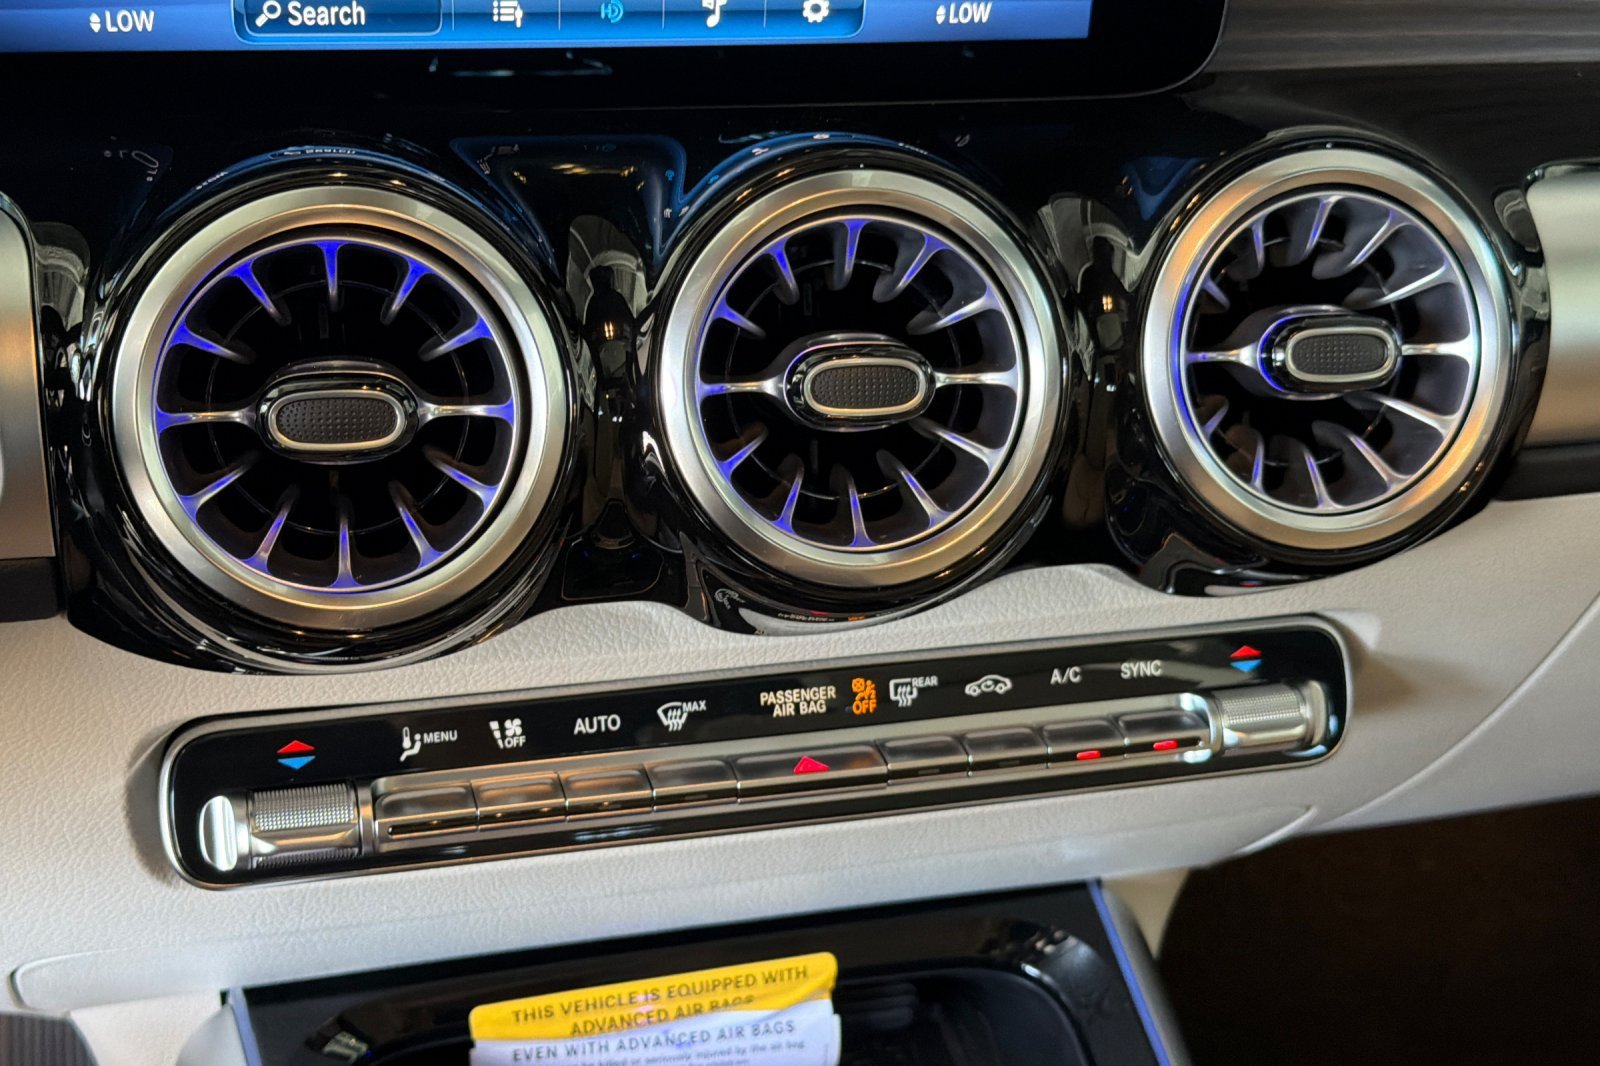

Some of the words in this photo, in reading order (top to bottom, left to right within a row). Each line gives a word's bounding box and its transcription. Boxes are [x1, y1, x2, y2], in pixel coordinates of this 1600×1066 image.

[105, 11, 155, 33] LOW
[287, 0, 366, 27] Search
[949, 3, 992, 24] LOW
[1050, 666, 1082, 685] A/C
[1120, 660, 1163, 679] SYNC
[912, 675, 939, 688] REAR
[760, 685, 836, 706] PASSENGER
[682, 700, 707, 713] MAX
[773, 702, 795, 717] AIR
[800, 700, 827, 715] BAG
[852, 700, 877, 715] OFF
[573, 713, 621, 735] AUTO
[423, 730, 458, 744] MENU
[505, 735, 526, 748] OFF
[512, 1004, 555, 1024] THIS
[560, 990, 640, 1016] VEHICLE
[643, 988, 660, 1003] IS
[667, 973, 757, 999] EQUIPPED
[761, 965, 808, 985] WITH
[570, 1008, 669, 1036] ADVANCED
[674, 1002, 703, 1020] AIR
[709, 994, 755, 1012] BAGS
[512, 1044, 558, 1062] EVEN
[565, 1039, 609, 1057] WITH
[616, 1029, 711, 1052] ADVANCED
[717, 1025, 745, 1041] AIR
[752, 1020, 796, 1037] BAGS
